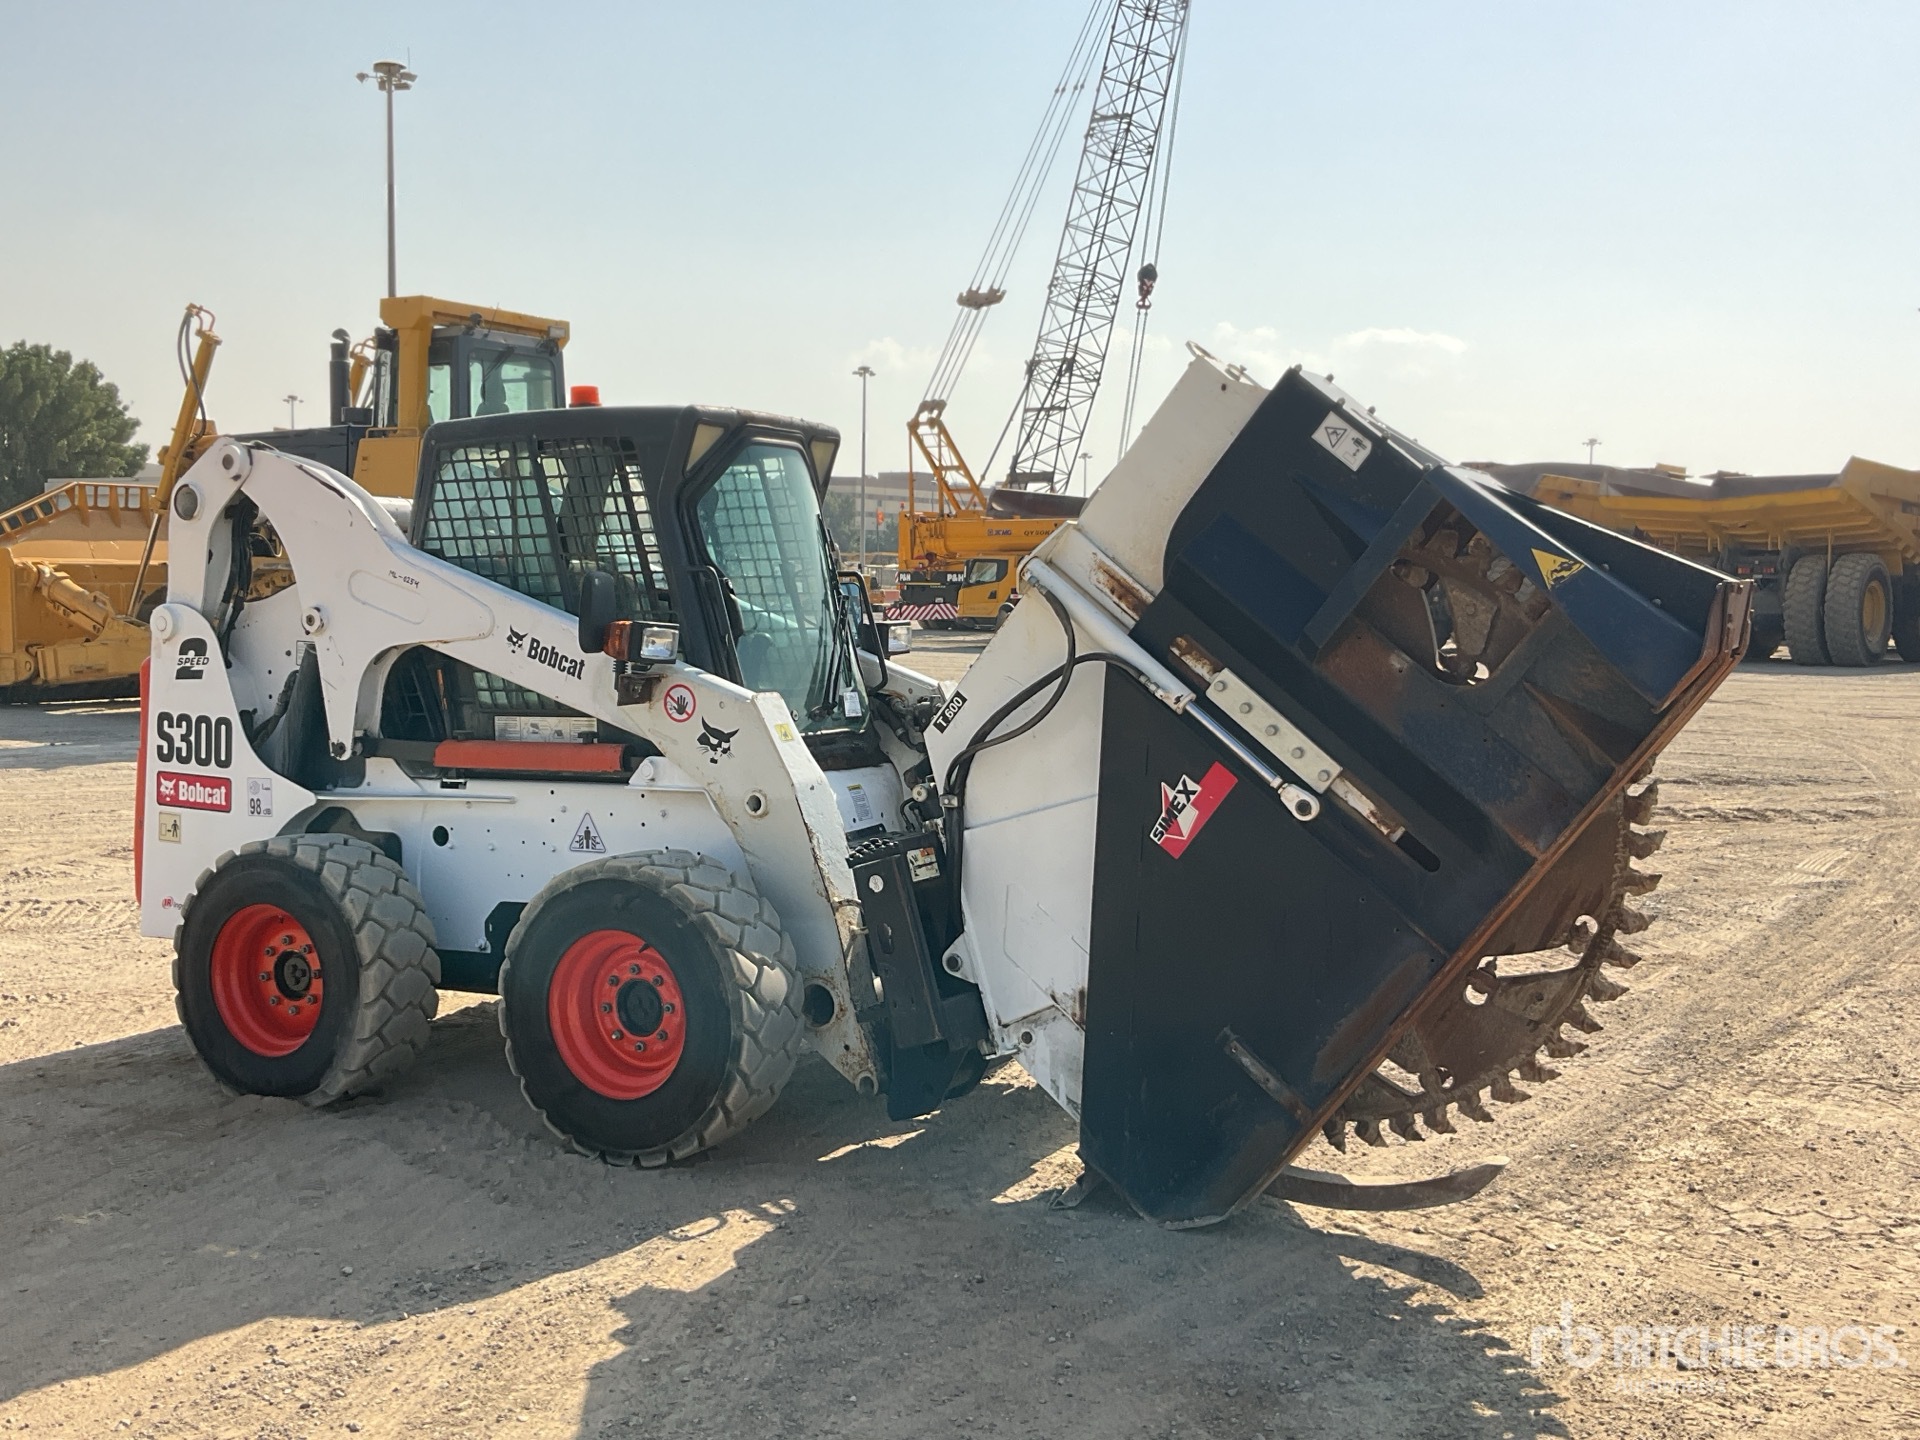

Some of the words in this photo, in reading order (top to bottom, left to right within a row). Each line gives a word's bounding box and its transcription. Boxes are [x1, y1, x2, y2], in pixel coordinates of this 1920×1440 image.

[899, 573, 912, 582] P&H
[946, 573, 964, 582] P&H
[175, 637, 208, 680] 2
[177, 656, 210, 666] SPEED
[527, 636, 586, 681] Bobcat
[936, 715, 948, 728] T
[944, 696, 964, 720] 600
[156, 711, 233, 769] S300
[178, 779, 227, 806] Bobcat
[249, 797, 262, 815] 98
[1152, 776, 1200, 843] SIMEX
